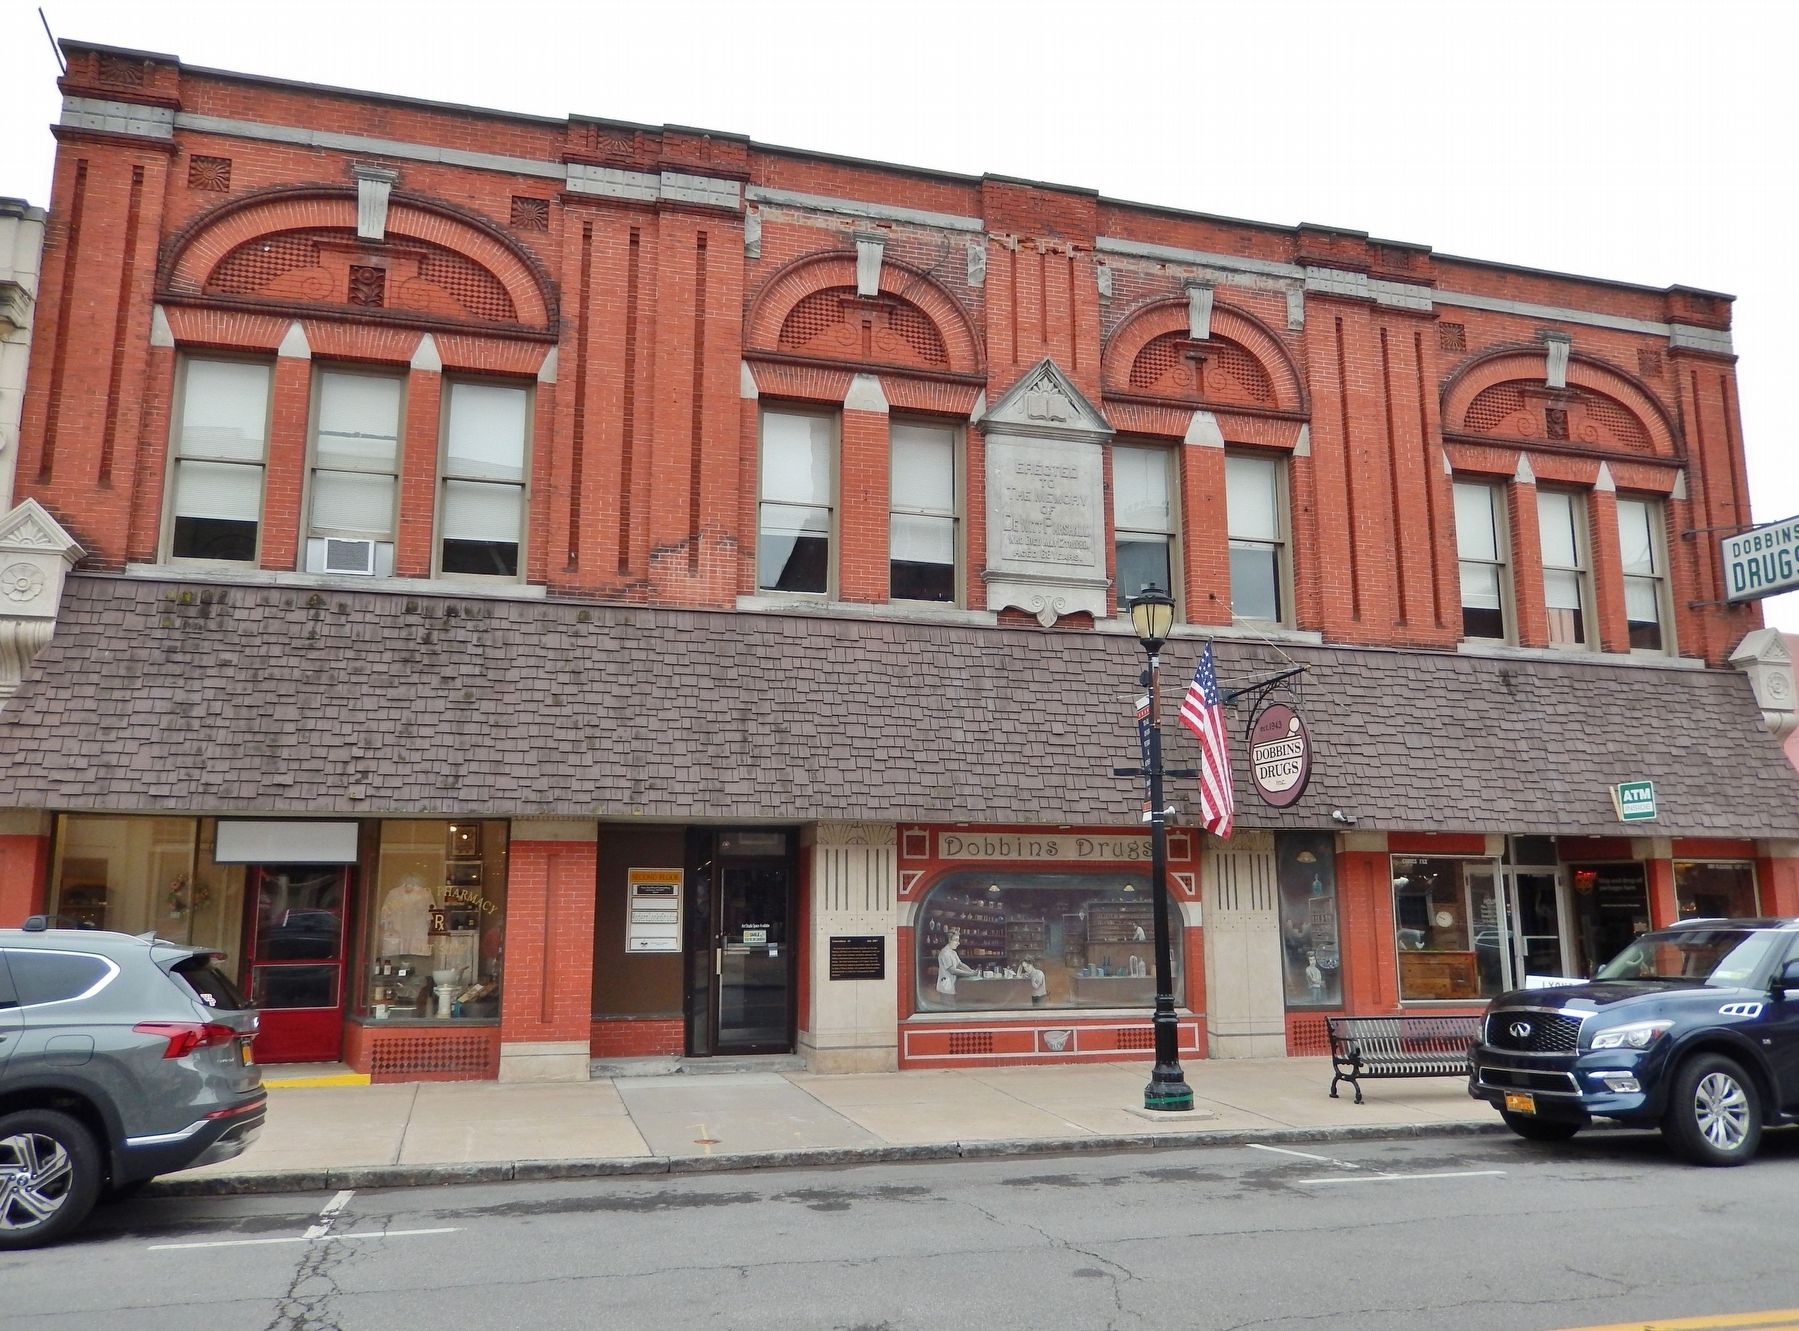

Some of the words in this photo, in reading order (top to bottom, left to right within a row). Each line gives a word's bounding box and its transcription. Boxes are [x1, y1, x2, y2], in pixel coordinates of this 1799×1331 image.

[1255, 741, 1302, 762] DOBBINS
[1259, 761, 1299, 780] DRUGS
[1623, 788, 1651, 801] ATM
[944, 835, 1059, 857] Dobbins
[1075, 837, 1153, 860] Drugs
[437, 886, 498, 915] PHARMACY
